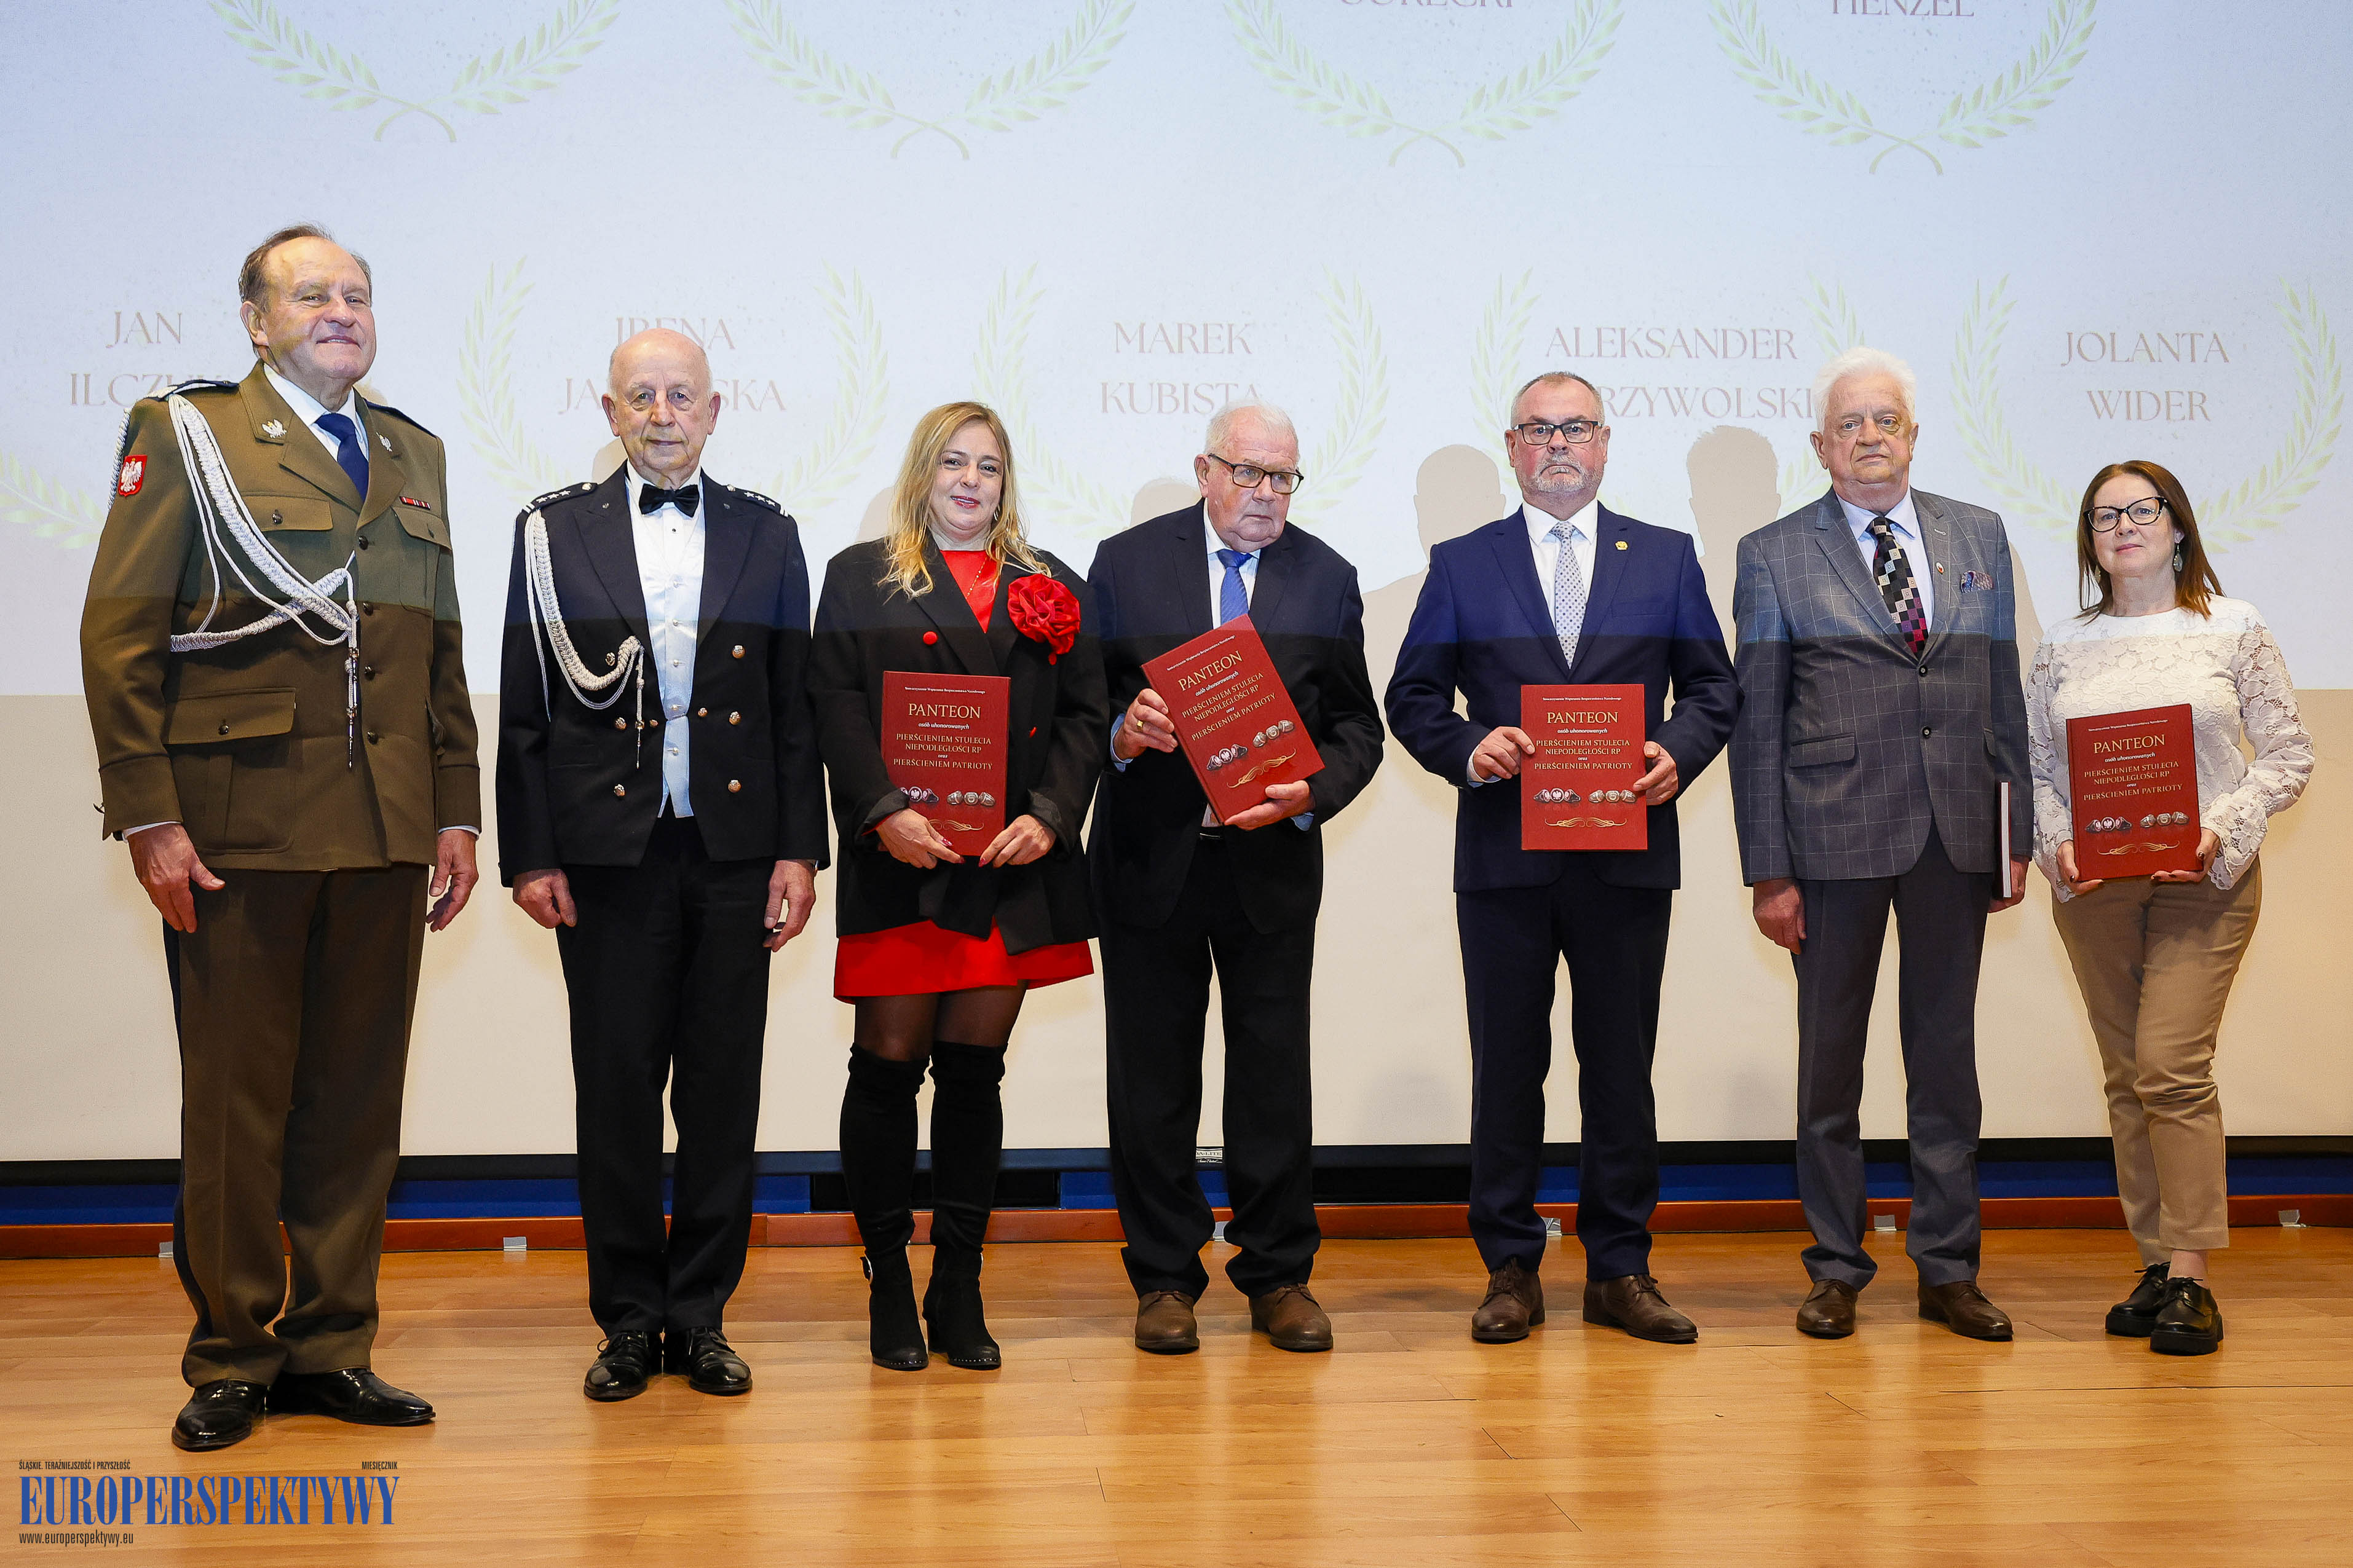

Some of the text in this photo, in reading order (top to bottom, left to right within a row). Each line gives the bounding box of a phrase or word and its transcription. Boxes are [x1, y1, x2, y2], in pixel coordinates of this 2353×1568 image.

[106, 312, 182, 349] JAN
[616, 317, 735, 349] IRNA
[1114, 323, 1252, 354] MAREK
[1546, 327, 1799, 359] ALEKSANDER
[2061, 333, 2229, 366] JOLANTA
[2086, 390, 2212, 422] WIDER
[1178, 651, 1244, 691] PANTEON
[1205, 671, 1239, 692] uhonorowanych
[1182, 673, 1264, 718] PIERŚCIENIEM STULECIA
[1195, 685, 1260, 722] NIEPODLEGŁOŚCI RP
[909, 703, 981, 719] PANTEON
[1192, 693, 1276, 741] PIERŚCIENIEM PATRIOTY
[1547, 712, 1618, 723] PANTEON
[896, 733, 952, 743] PIERŚCIENIEM
[906, 743, 970, 753] NIEPODLEGŁOŚCI
[2094, 735, 2165, 753] PANTEON
[893, 758, 949, 767] PIERŚCIENIEM
[2118, 752, 2155, 761] uhonorowanych
[2084, 761, 2178, 777] PIERŚCIENIEM STULECIA
[2094, 771, 2157, 784] NIEPODLEGŁOŚCI
[2084, 784, 2182, 800] PIERŚCIENIEM PATRIOTY
